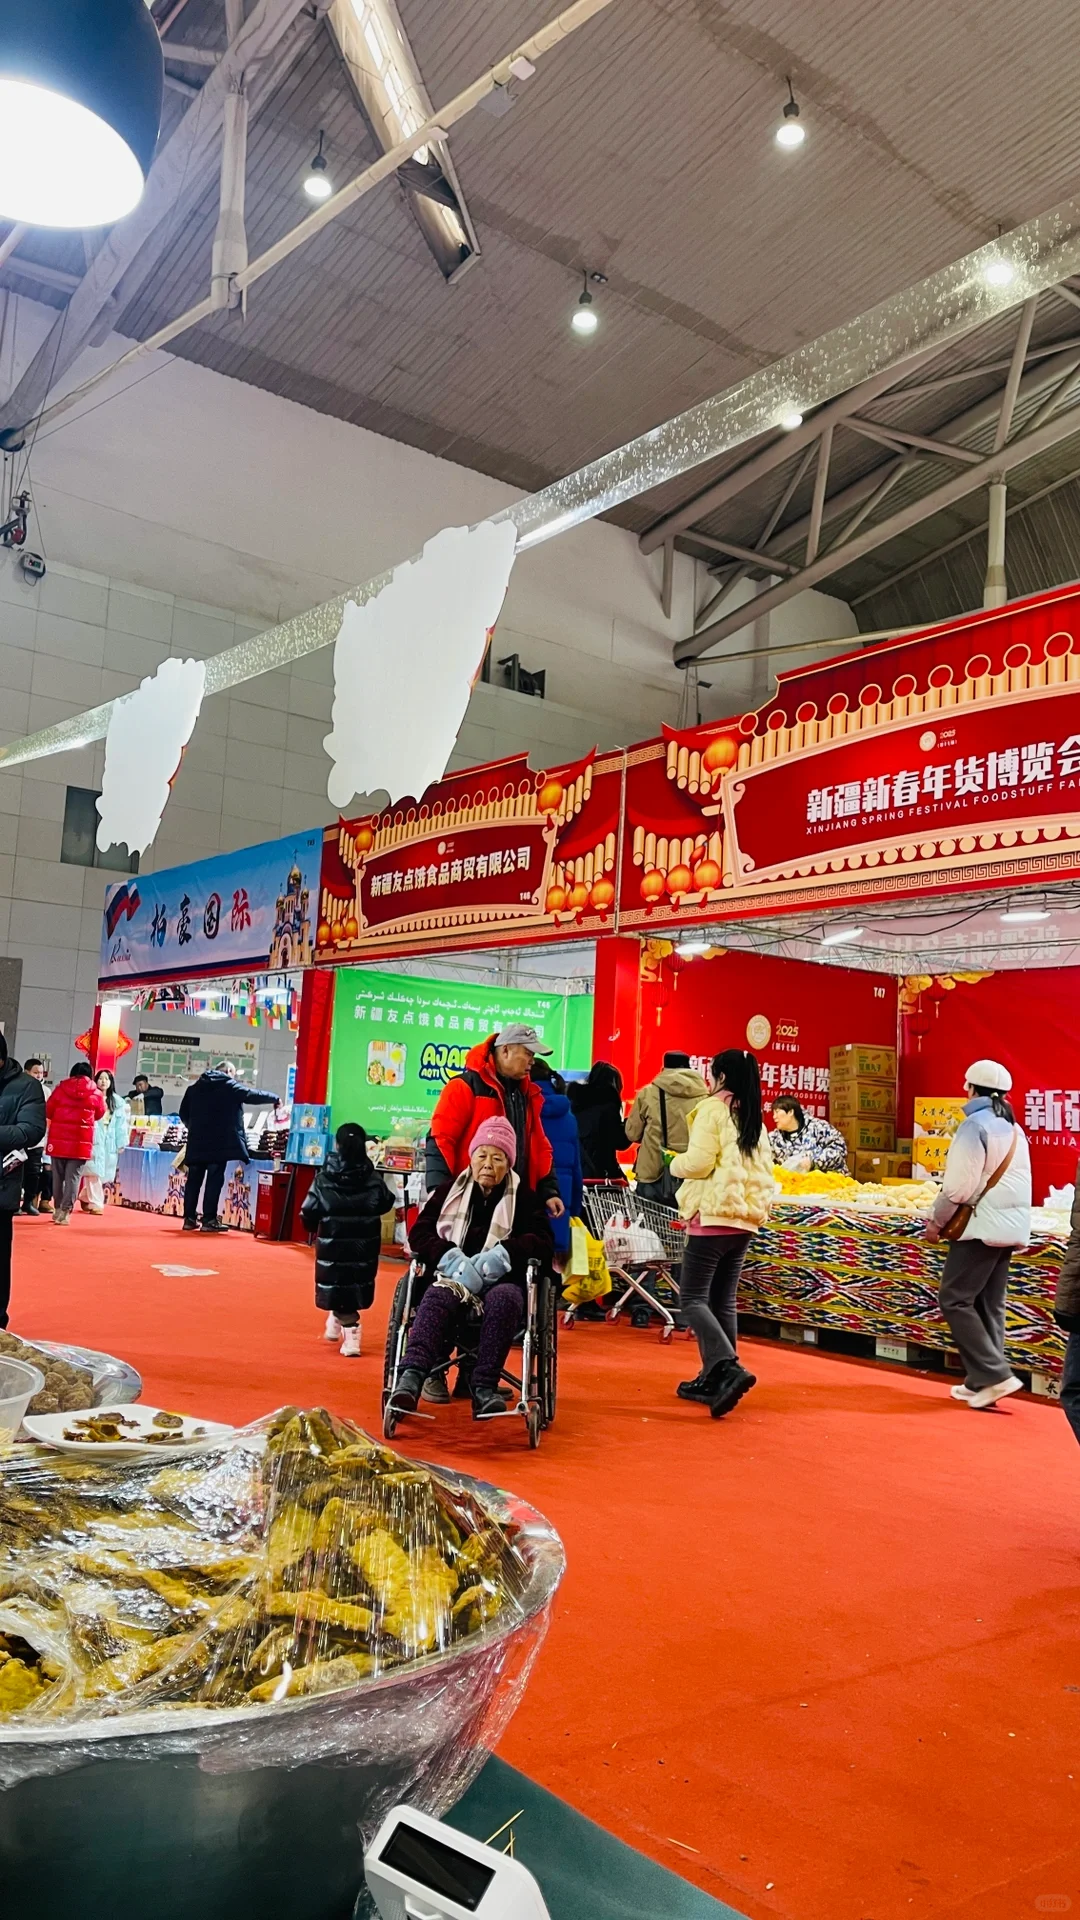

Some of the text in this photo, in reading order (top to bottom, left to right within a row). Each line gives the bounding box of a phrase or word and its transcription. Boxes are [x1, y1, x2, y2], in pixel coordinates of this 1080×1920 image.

[806, 734, 1080, 823] 新疆新春年货博览会
[806, 818, 858, 835] XINJIANG
[861, 810, 904, 826] SPRING
[909, 800, 968, 817] FESTIVAL
[973, 783, 1054, 805] FOODSTUFF
[370, 846, 531, 897] 新疆友点饿食品商贸有限公司
[519, 892, 531, 901] T46
[873, 986, 886, 998] T47
[353, 1004, 545, 1039] 新疆友点饿食品商贸有司
[775, 1024, 799, 1038] 2025
